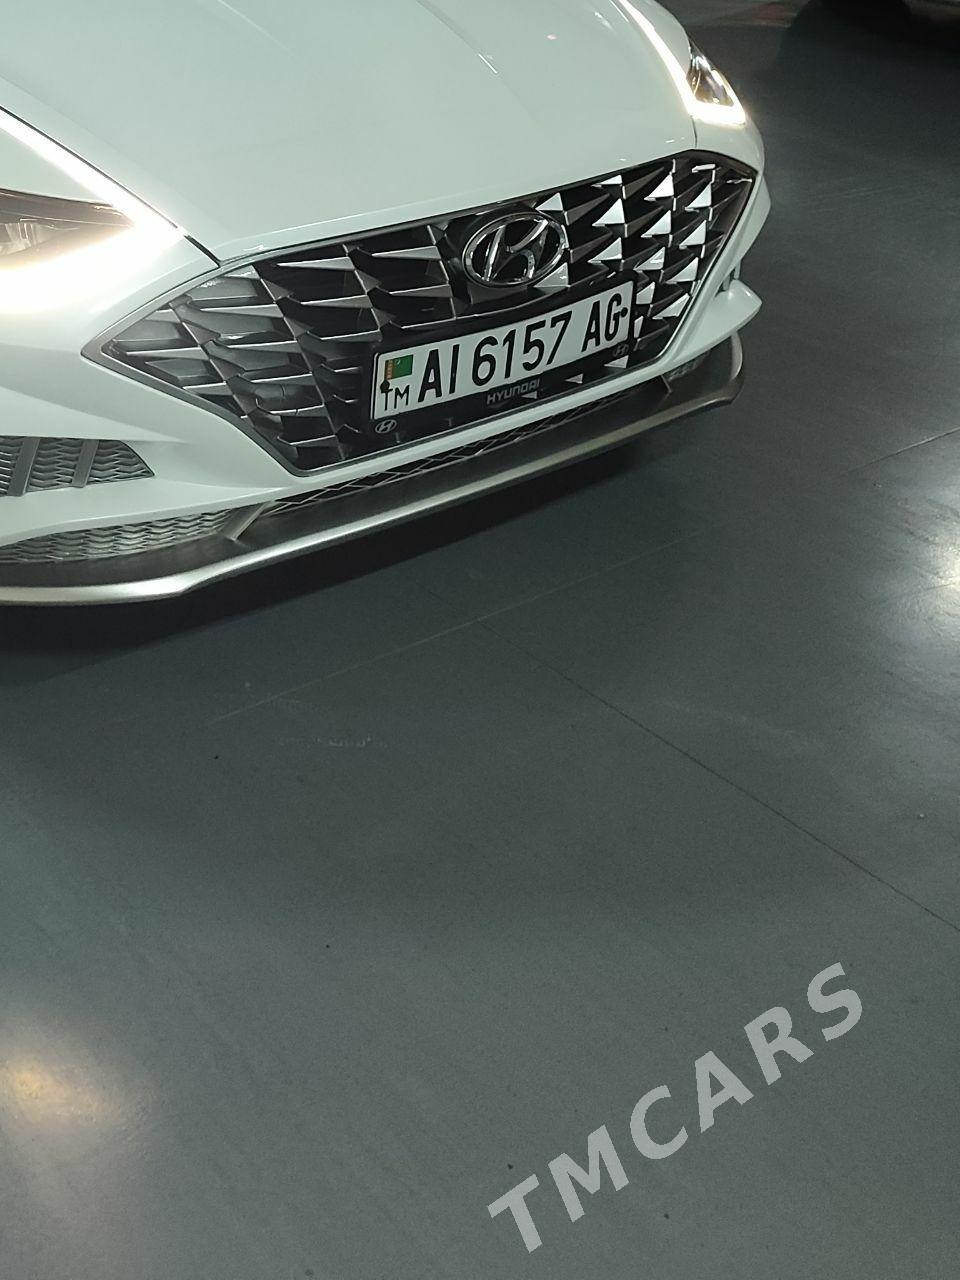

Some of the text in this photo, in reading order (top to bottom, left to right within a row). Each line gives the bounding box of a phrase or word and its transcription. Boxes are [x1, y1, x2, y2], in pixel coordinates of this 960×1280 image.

[418, 293, 622, 403] AI 6157 AG
[486, 378, 540, 406] HYUNDAI
